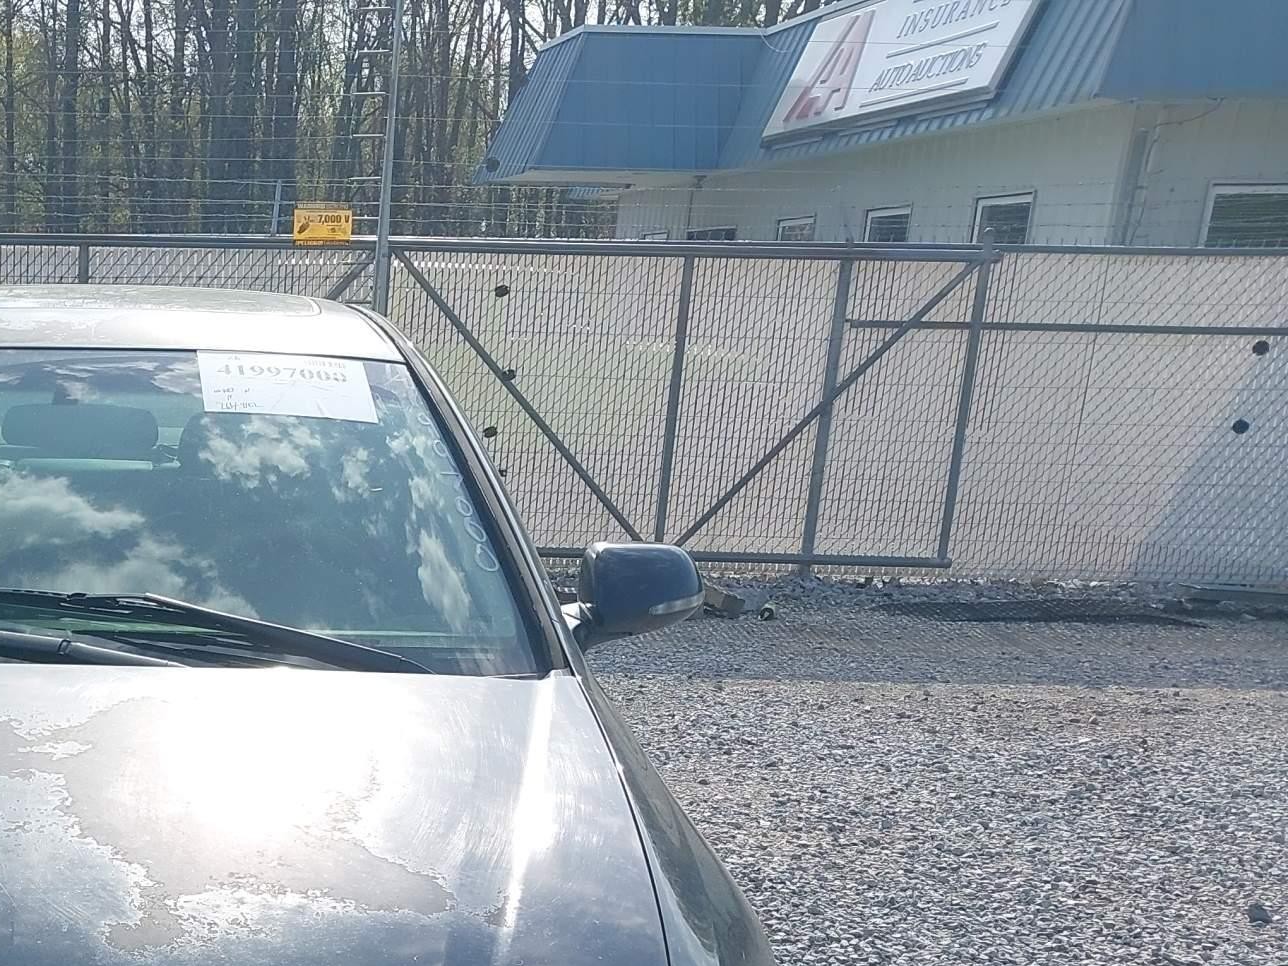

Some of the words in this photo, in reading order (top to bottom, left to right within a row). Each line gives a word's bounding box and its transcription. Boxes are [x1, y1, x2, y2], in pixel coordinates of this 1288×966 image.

[897, 0, 1010, 39] INSURANC
[317, 214, 342, 225] 7,000
[344, 214, 350, 223] V
